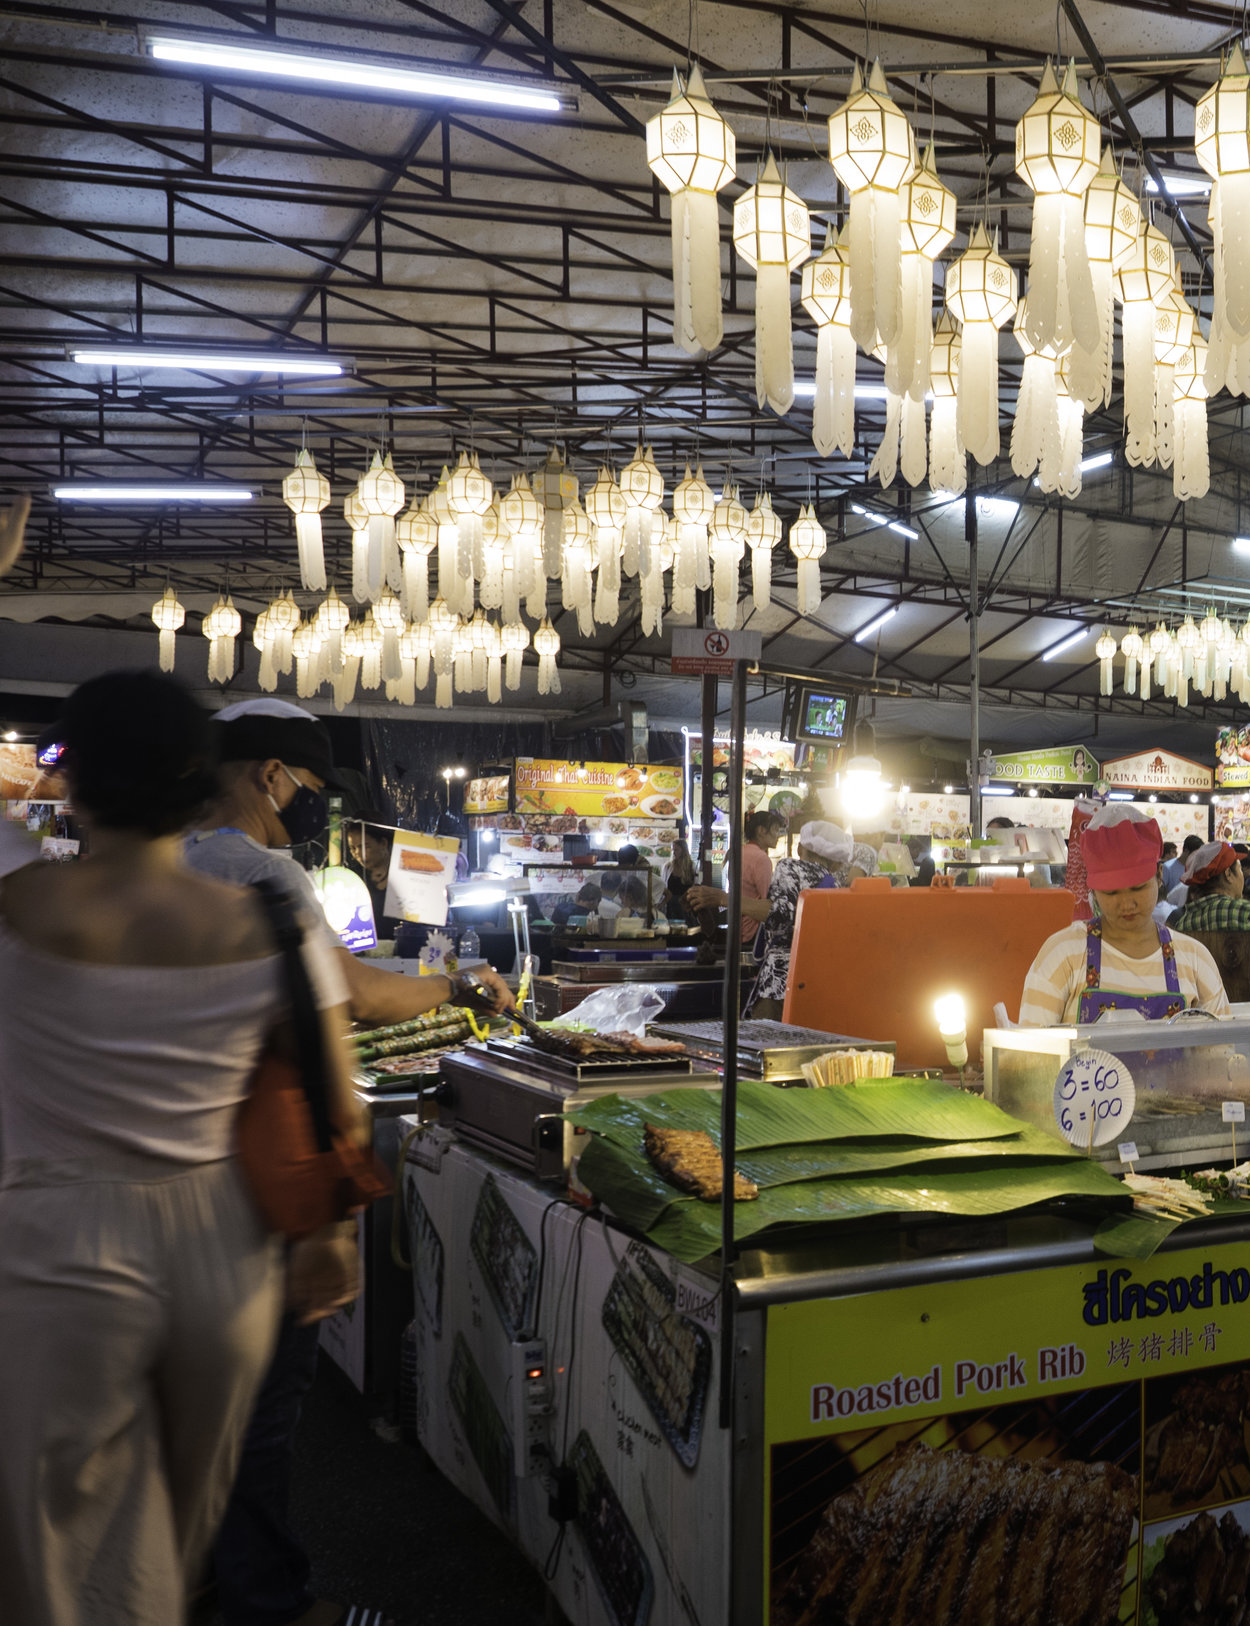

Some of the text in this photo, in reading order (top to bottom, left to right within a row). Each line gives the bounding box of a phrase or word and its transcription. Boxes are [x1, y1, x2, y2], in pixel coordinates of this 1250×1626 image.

[516, 764, 614, 788] Original Thai Cuisine
[994, 763, 1066, 779] OOD TASTE
[1105, 772, 1210, 786] NAINA INDIAN FOOD
[1223, 771, 1249, 781] Stewed
[1075, 1056, 1097, 1070] Begin
[678, 1283, 717, 1326] BW104
[810, 1321, 1223, 1423] Roasted Pork Rib 烤猪排骨
